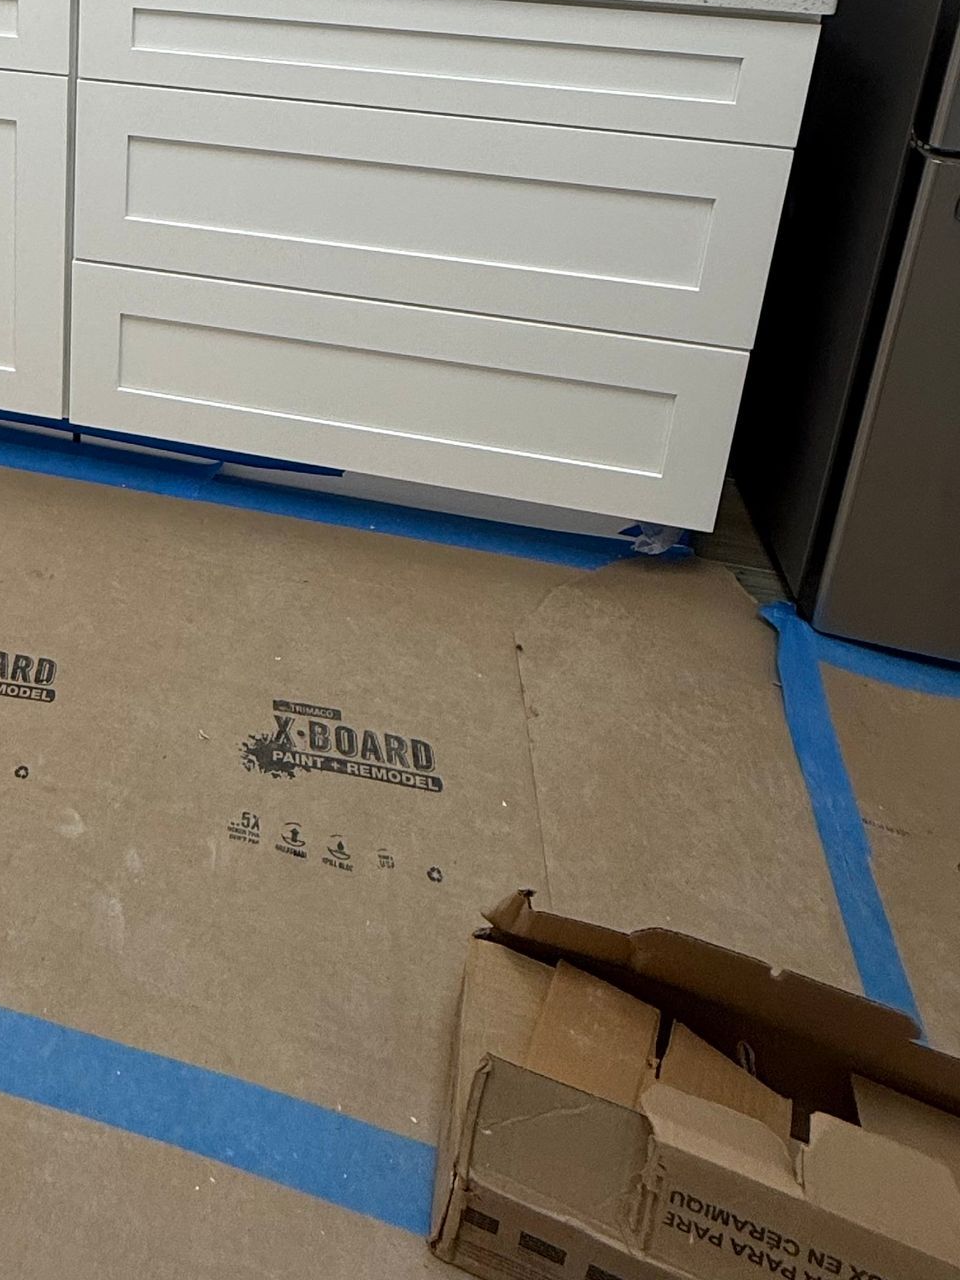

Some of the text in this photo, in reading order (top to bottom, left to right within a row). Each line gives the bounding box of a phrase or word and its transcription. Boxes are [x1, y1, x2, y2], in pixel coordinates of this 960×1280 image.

[290, 703, 334, 719] TRIMACO
[272, 750, 324, 769] PAINT
[346, 762, 440, 791] REMODEL
[662, 1210, 723, 1248] PARE
[730, 1237, 797, 1280] PARA
[808, 1248, 843, 1276] EN
